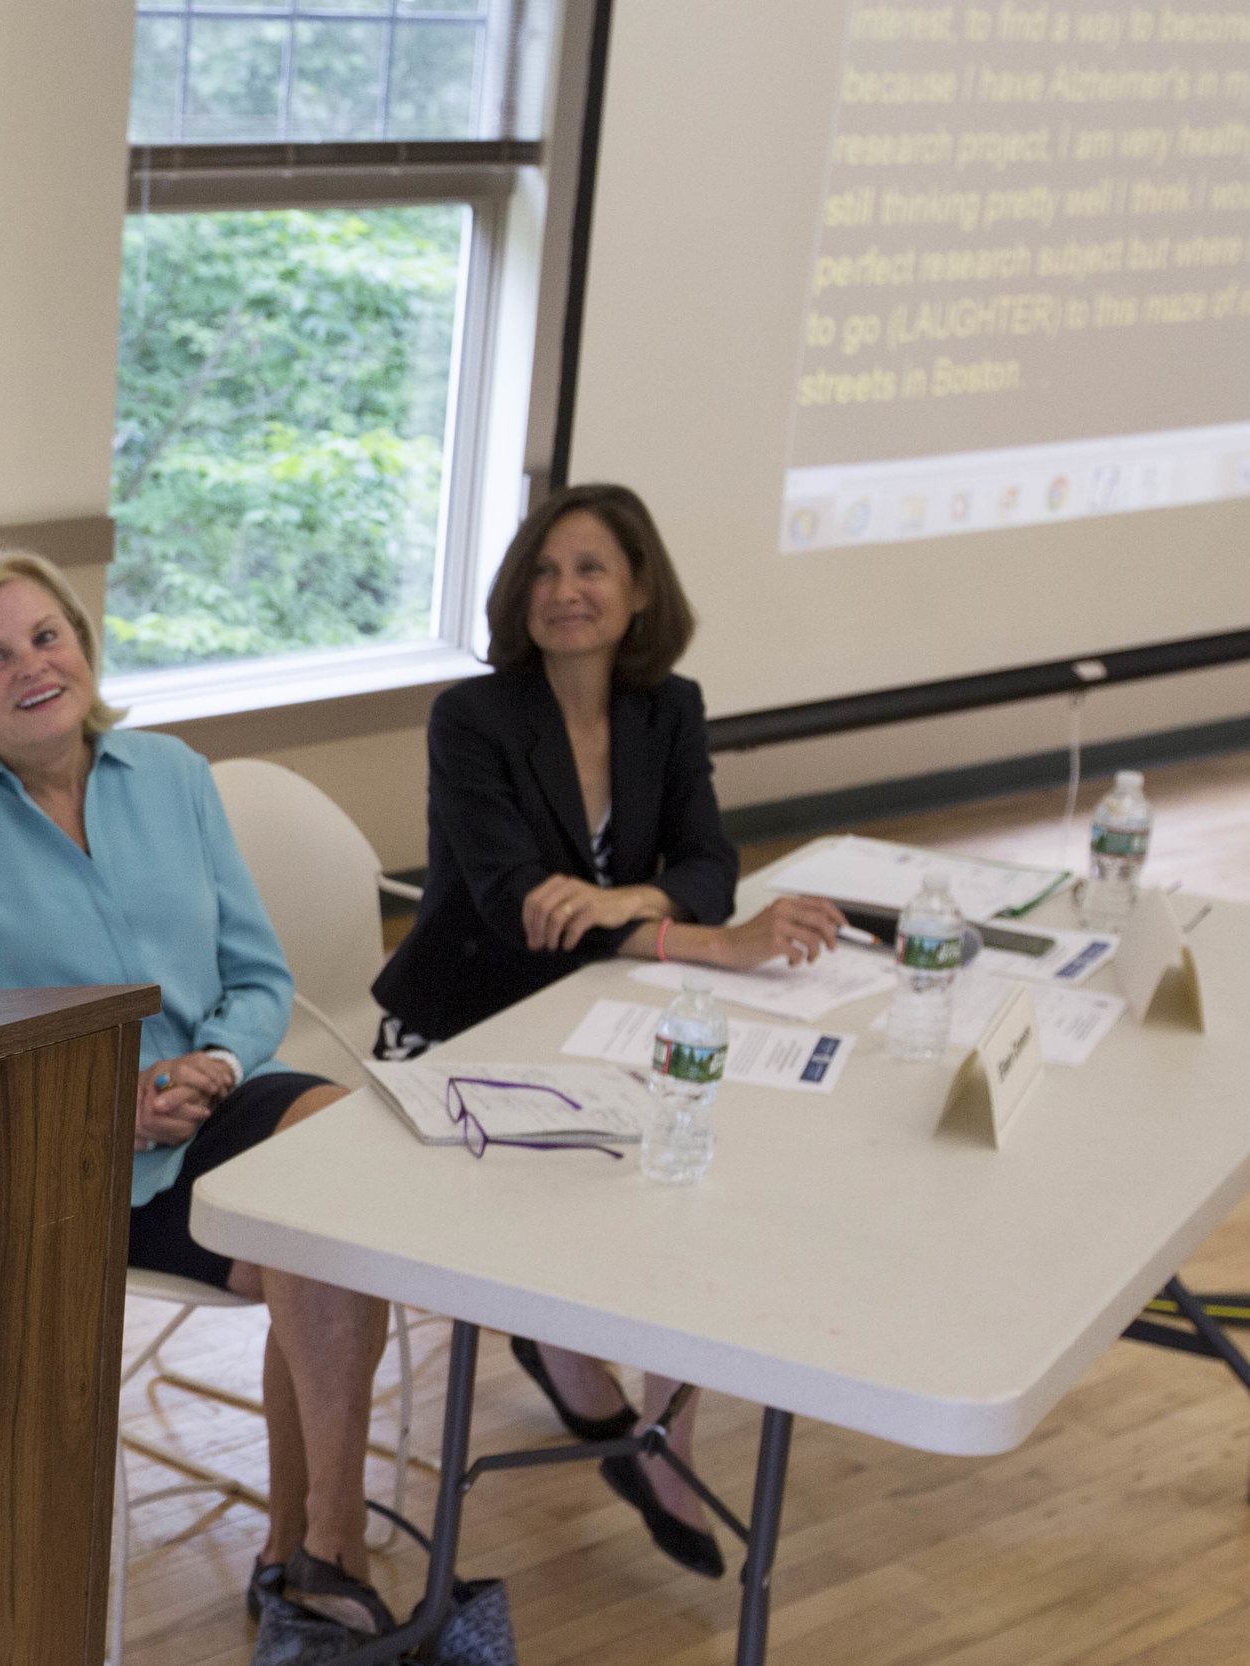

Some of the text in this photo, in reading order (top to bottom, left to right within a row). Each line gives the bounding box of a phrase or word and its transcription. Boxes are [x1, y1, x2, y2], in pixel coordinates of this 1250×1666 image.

[964, 6, 991, 41] to
[997, 2, 1048, 42] find
[1051, 11, 1069, 42] a
[1075, 12, 1120, 52] way
[1129, 8, 1153, 41] to
[842, 60, 957, 103] because
[980, 60, 1046, 102] have
[1049, 62, 1190, 102] Alzheimer's
[1197, 64, 1220, 98] in
[831, 123, 952, 166] research
[1074, 127, 1114, 161] am
[1118, 126, 1170, 167] very
[822, 184, 877, 228] still
[880, 182, 980, 232] thinking
[983, 184, 1057, 231] pretty
[1064, 176, 1114, 217] well
[1129, 175, 1190, 215] think
[812, 246, 916, 296] perfect
[919, 240, 1032, 283] research
[1036, 236, 1123, 282] subject
[1126, 234, 1170, 272] but
[806, 308, 837, 347] to
[840, 312, 881, 355] go
[886, 292, 1064, 353] (LAUGHTER)
[1143, 291, 1209, 325] maze
[1211, 278, 1239, 319] of
[798, 367, 898, 407] streets
[900, 365, 927, 400] in
